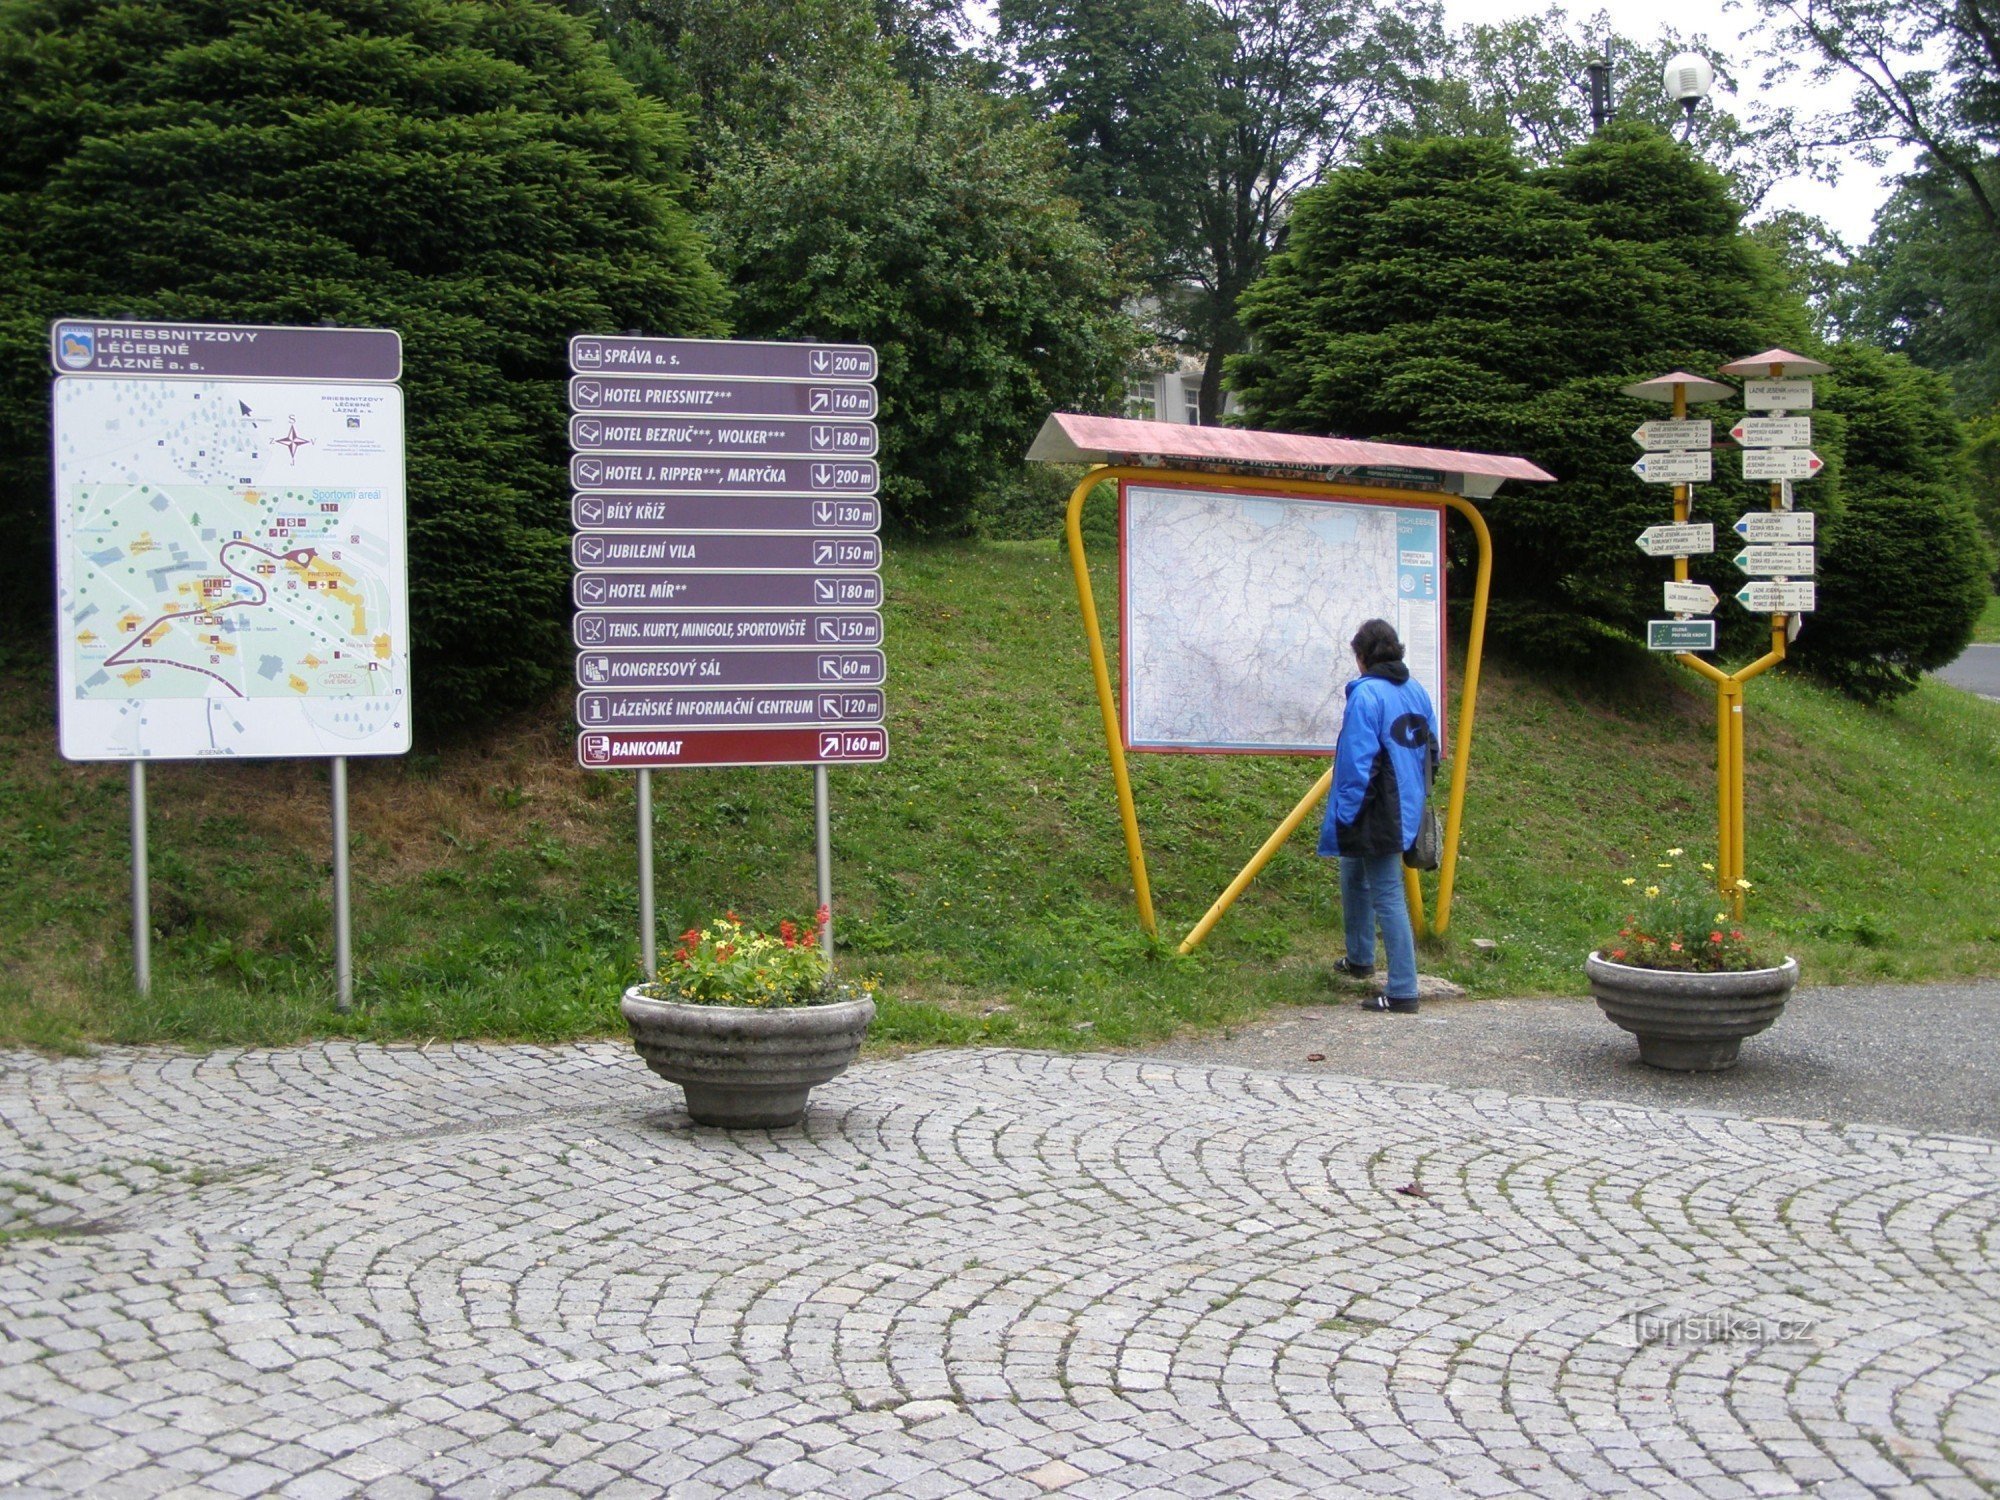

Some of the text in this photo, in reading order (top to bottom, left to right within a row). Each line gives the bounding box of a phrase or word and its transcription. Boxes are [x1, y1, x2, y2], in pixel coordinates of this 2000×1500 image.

[97, 328, 258, 343] PRIESSNITZOVY
[97, 341, 189, 356] LÉČEBNÉ
[97, 355, 205, 370] LÁZNĚ a. s.
[604, 346, 869, 371] SPRÁVA a. s. 200 m
[604, 388, 642, 403] HOTEL
[835, 394, 857, 408] 160
[858, 399, 869, 408] m
[288, 414, 296, 423] S
[604, 427, 642, 441] HOTEL
[836, 432, 858, 446] 180
[860, 437, 870, 446] m
[605, 466, 642, 480] HOTEL
[646, 468, 656, 481] J.
[727, 466, 786, 483] MARYČKA
[836, 470, 858, 484] 200
[860, 475, 871, 484] m
[312, 489, 381, 500] Sportovní areál
[607, 502, 872, 522] BÍLÝ KŘÍŽ 130 m
[606, 541, 874, 560] JUBILEJNÍ VILA 150 m
[609, 584, 646, 598] HOTEL
[841, 585, 862, 598] 180
[864, 590, 874, 598] m
[609, 619, 875, 638] TENIS. KURTY, MINIGOLF, SPORTOVIŠTĚ 150 m
[612, 658, 870, 677] KONGRESOVÝ SÁL 60 m
[612, 697, 878, 717] LÁZEŇSKÉ INFORMAČNÍ CENTRUM 120 m
[612, 738, 880, 756] BANKOMAT 160 m
